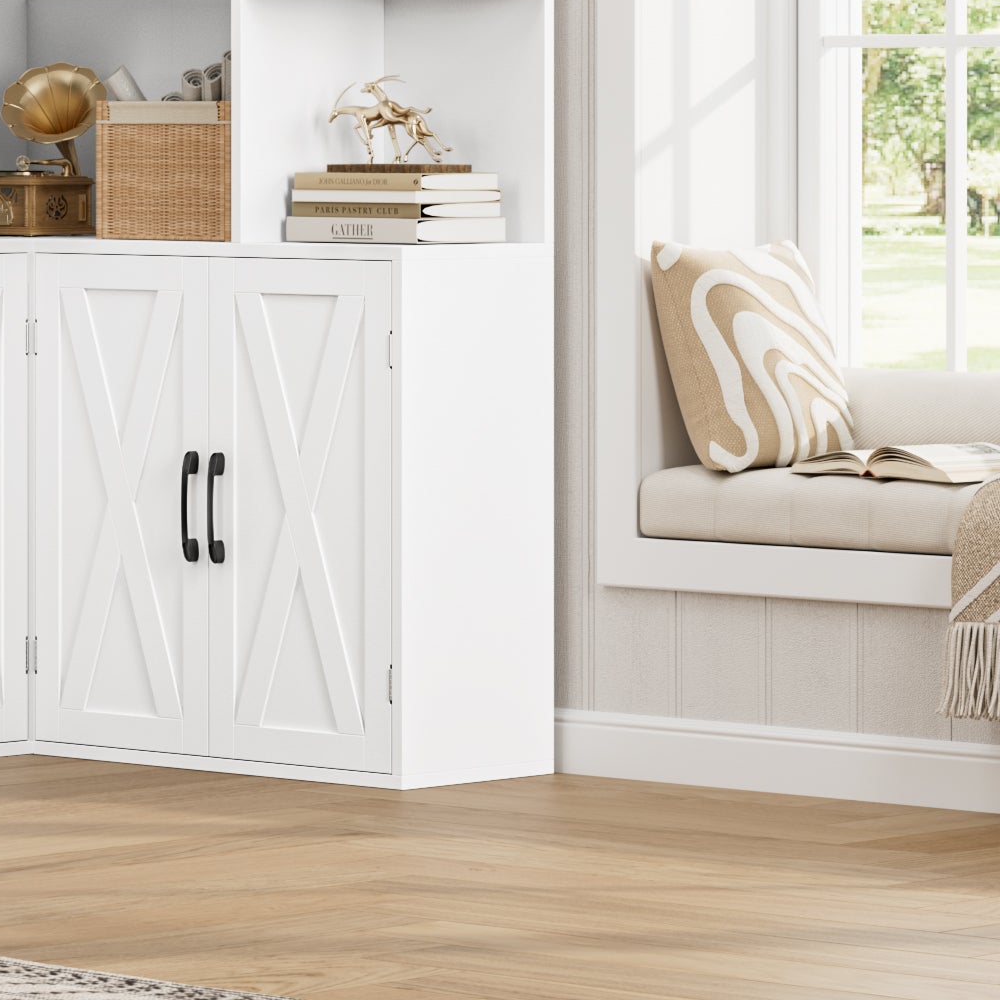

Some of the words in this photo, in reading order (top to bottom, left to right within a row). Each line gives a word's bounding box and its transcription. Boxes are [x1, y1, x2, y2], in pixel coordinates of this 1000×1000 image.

[315, 206, 339, 214] PARIS
[341, 206, 373, 215] PASTRY
[376, 207, 399, 215] CLUB
[331, 223, 373, 236] GATHER
